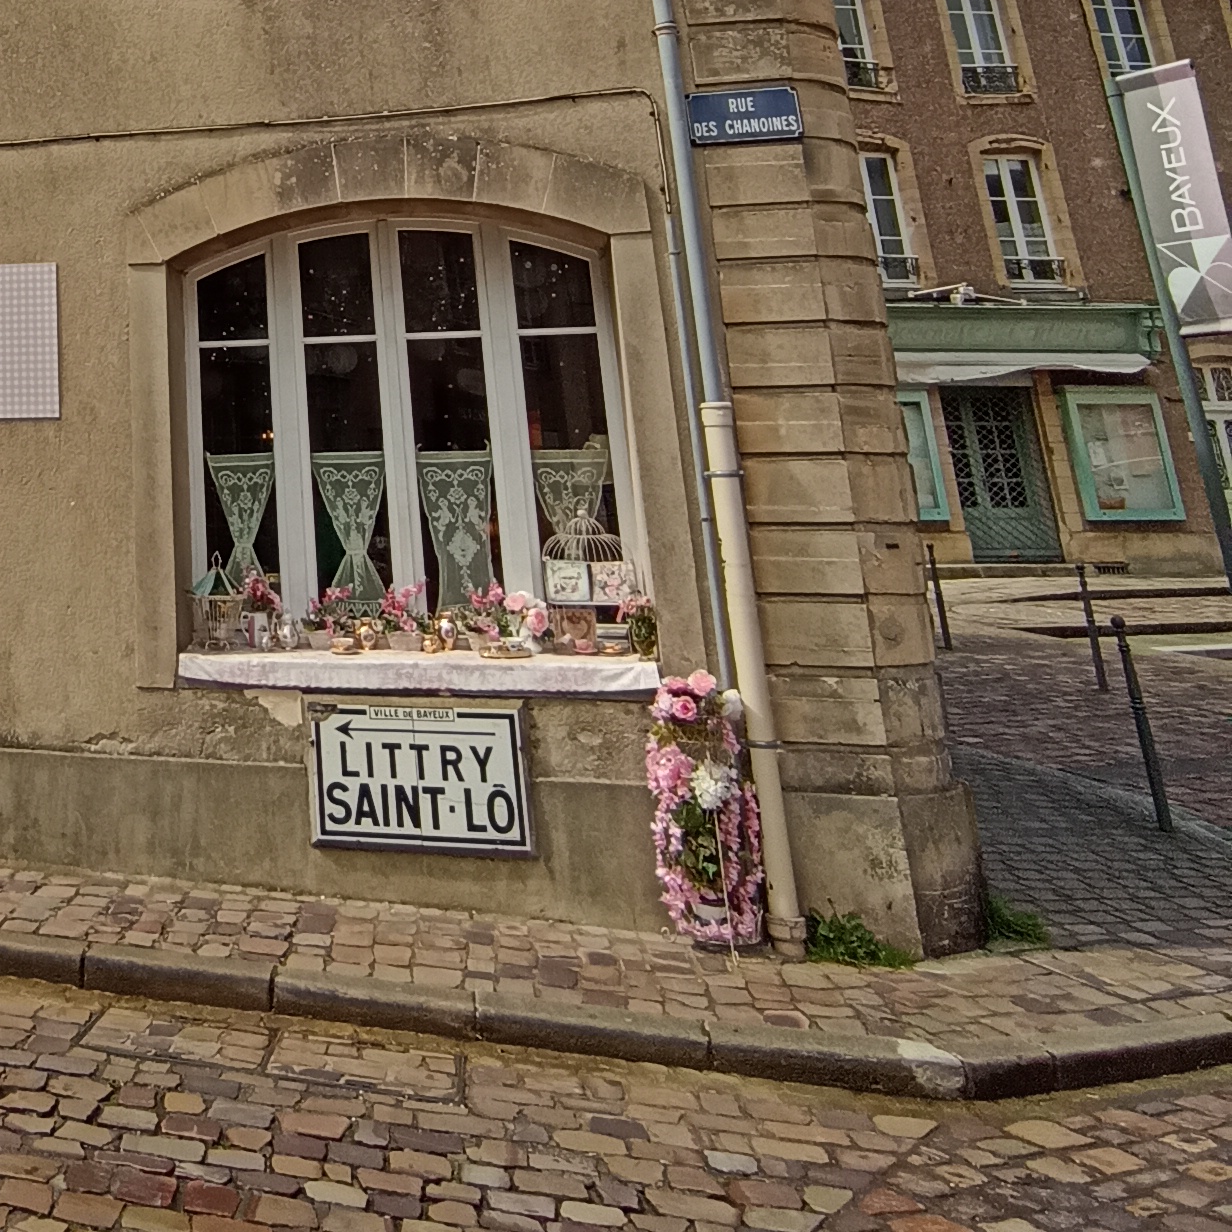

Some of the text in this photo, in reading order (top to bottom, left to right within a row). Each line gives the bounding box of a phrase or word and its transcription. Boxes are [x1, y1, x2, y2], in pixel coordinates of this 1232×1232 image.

[728, 97, 755, 113] RUE
[693, 115, 798, 137] DES CHANOINES
[1147, 97, 1204, 234] BAYEUX
[373, 709, 450, 719] VILLE DE BAYEUX
[339, 741, 493, 783] LITTRY
